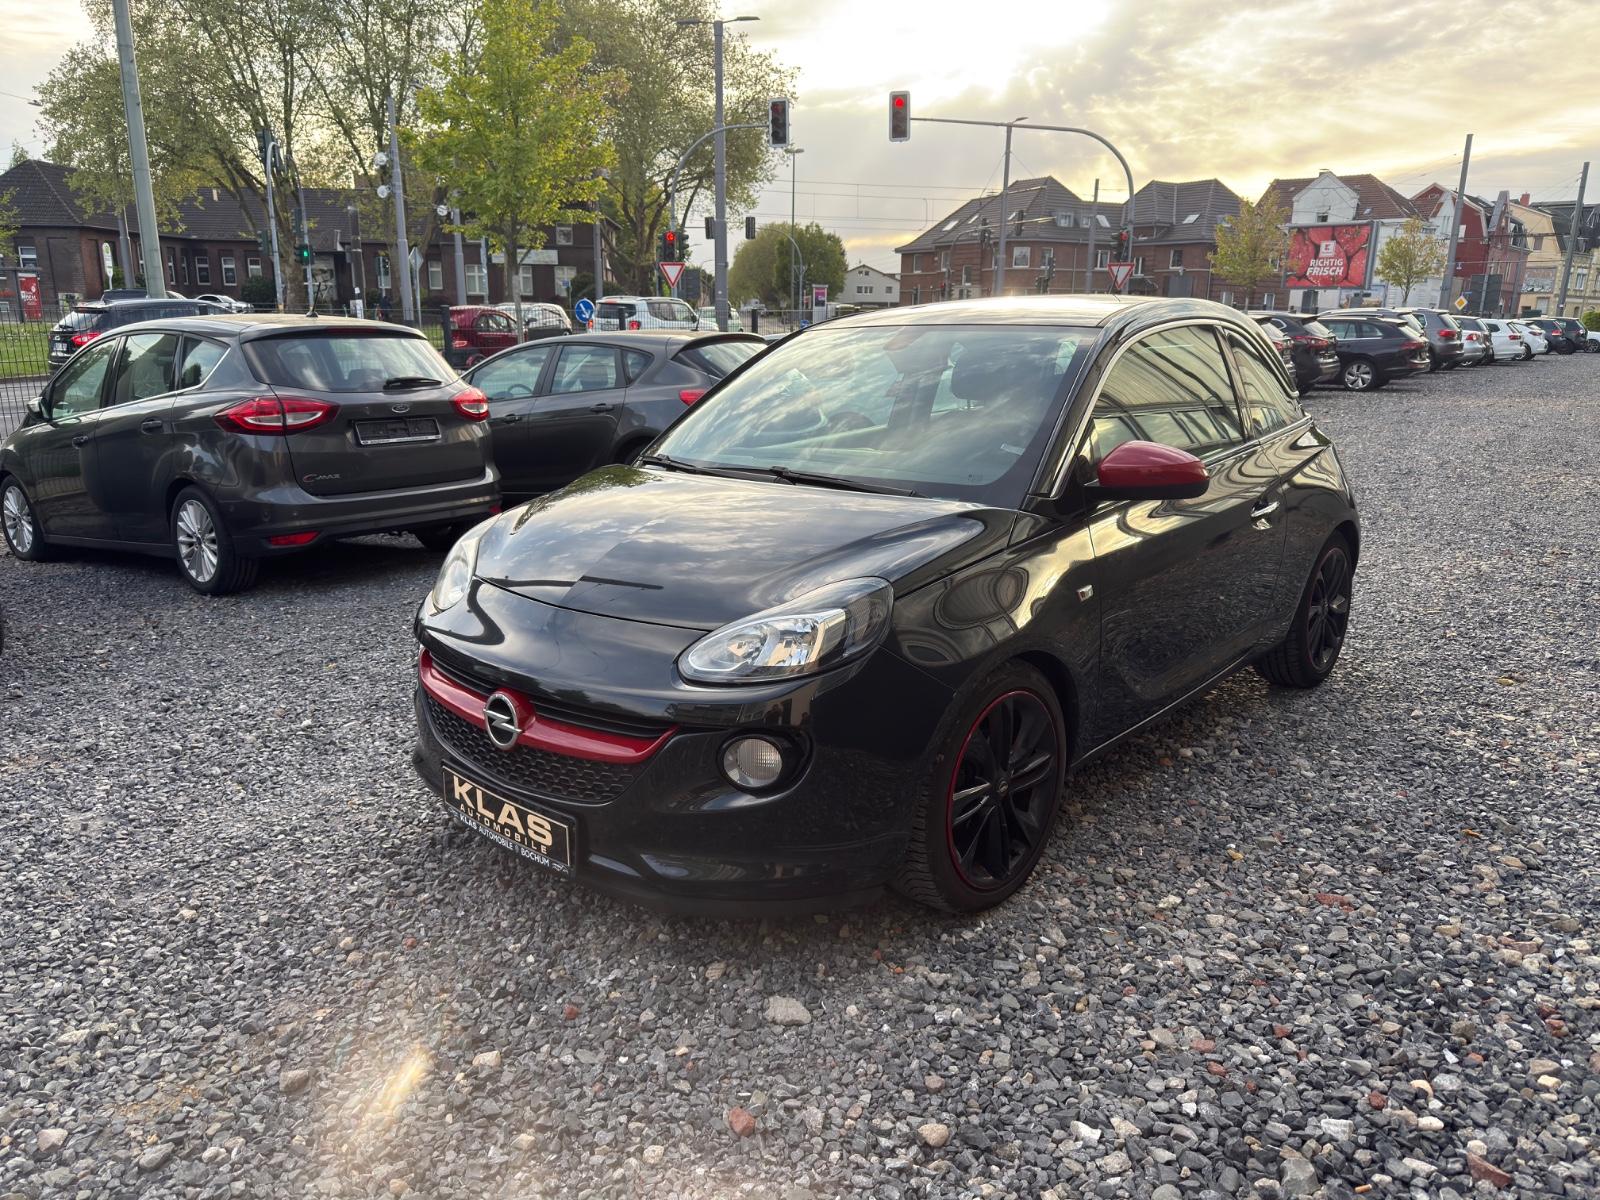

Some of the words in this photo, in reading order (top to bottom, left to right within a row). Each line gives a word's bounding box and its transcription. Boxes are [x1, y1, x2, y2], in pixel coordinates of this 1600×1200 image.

[1306, 267, 1344, 276] FRISCH
[1310, 259, 1343, 267] RICHTIG
[453, 775, 552, 846] KLAS
[460, 803, 547, 854] AUTOMOBILE
[460, 814, 477, 830] KLAS
[478, 826, 513, 850] AUTOMOBILE
[521, 847, 550, 867] BOCHUM
